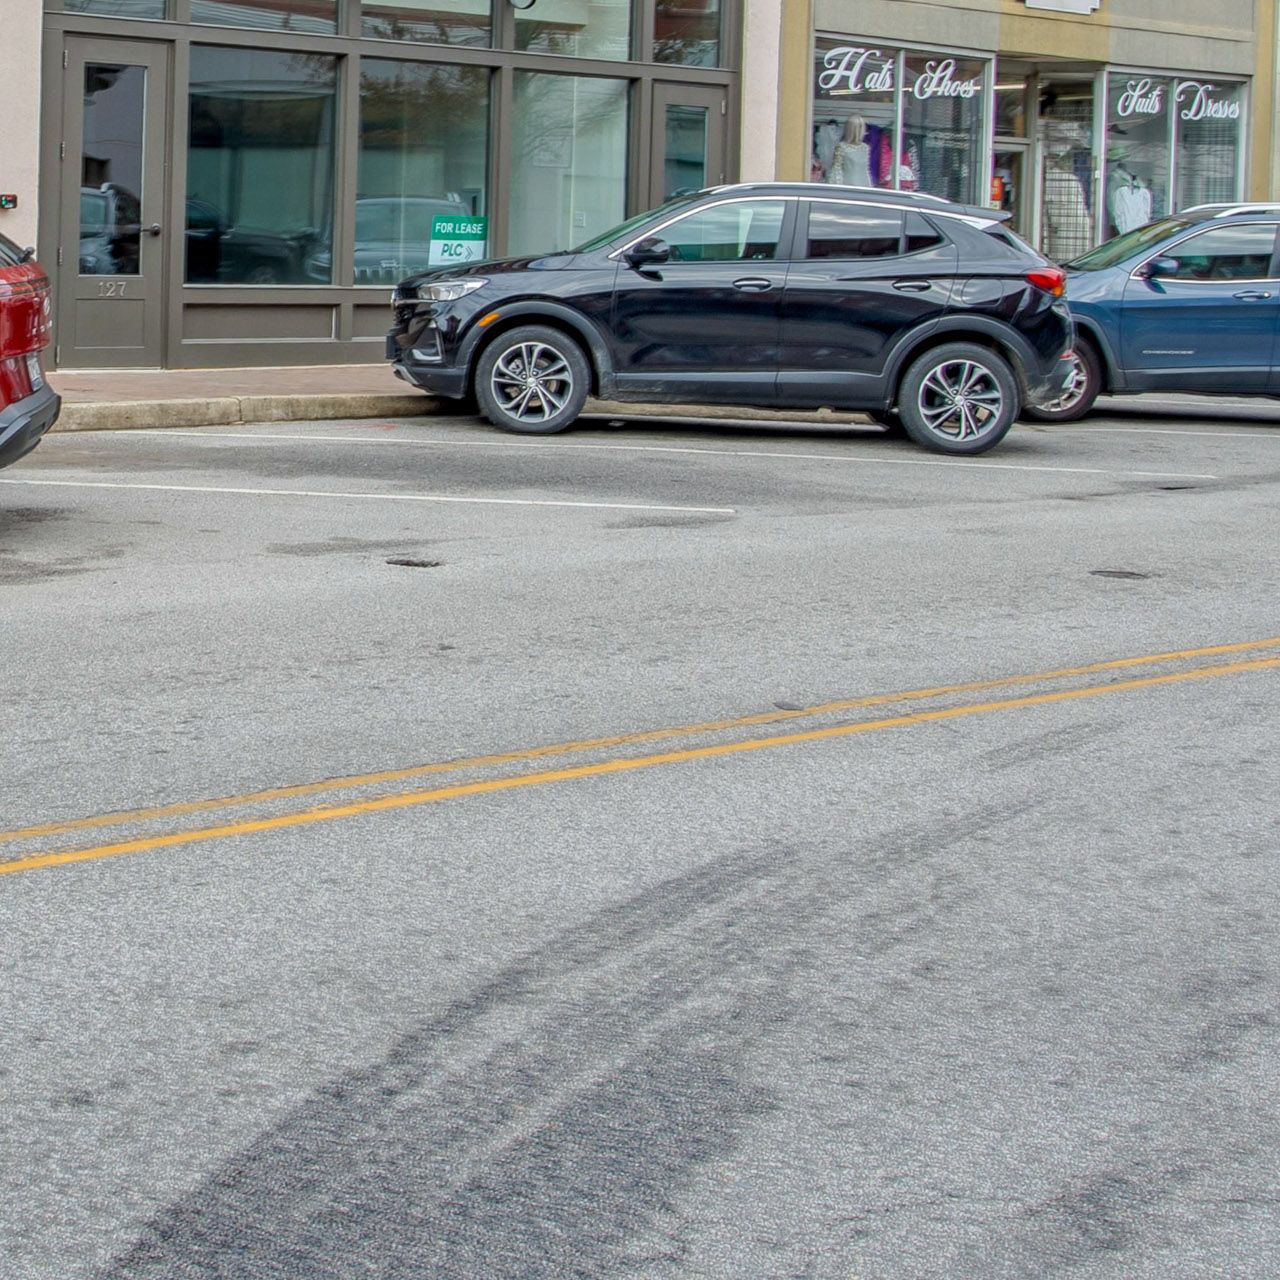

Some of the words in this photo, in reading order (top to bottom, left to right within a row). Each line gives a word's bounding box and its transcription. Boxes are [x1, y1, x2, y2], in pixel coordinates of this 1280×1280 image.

[819, 46, 895, 91] Hats
[914, 59, 977, 100] Shoes
[1117, 78, 1163, 116] Suits
[1175, 81, 1240, 120] Dresses
[435, 223, 453, 233] FOR
[455, 223, 483, 234] LEASE
[441, 243, 463, 257] PLC
[98, 281, 127, 297] 127
